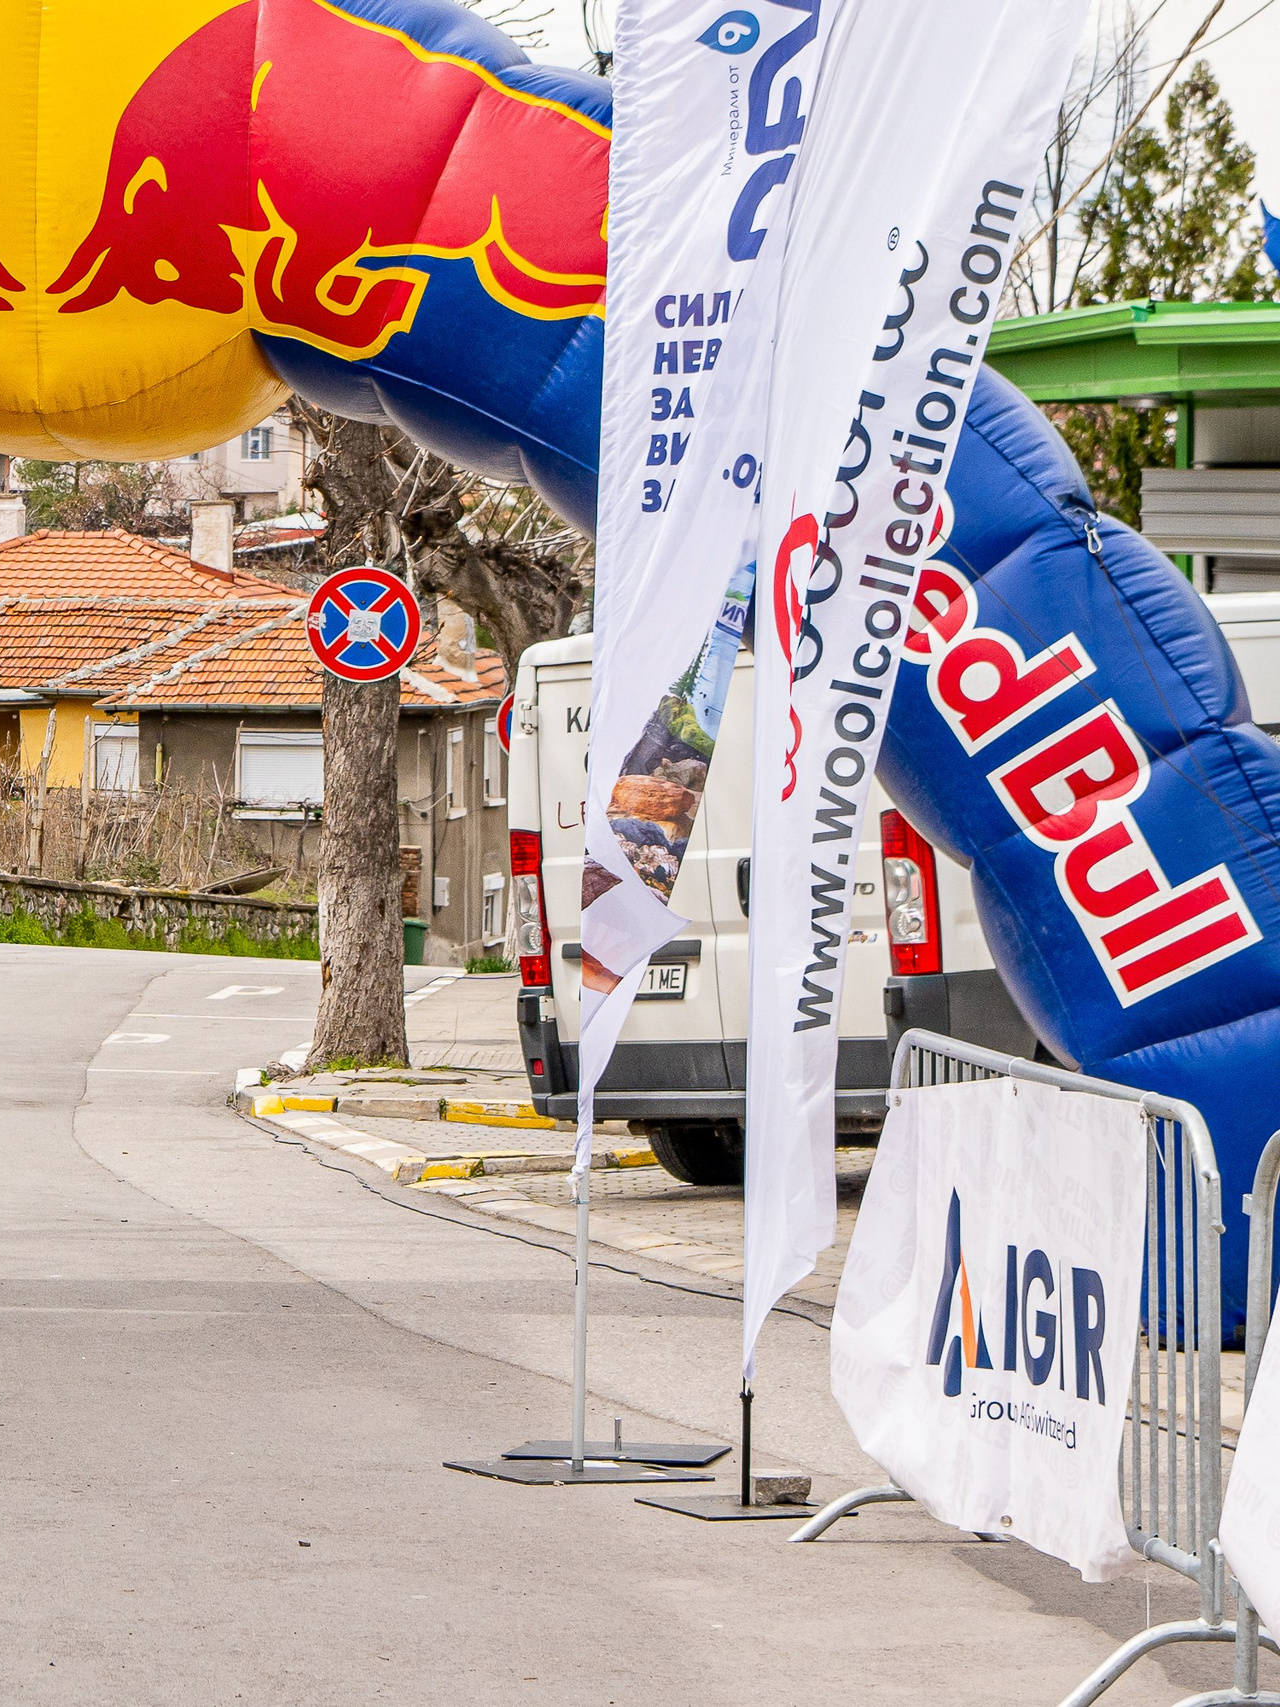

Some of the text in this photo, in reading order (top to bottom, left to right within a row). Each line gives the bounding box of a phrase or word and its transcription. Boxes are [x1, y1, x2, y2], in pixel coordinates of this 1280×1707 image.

[721, 86, 743, 177] Минерали
[654, 288, 744, 329] СИЛ
[793, 178, 1025, 1034] www.woolcollection.com
[995, 707, 1254, 998] Bull
